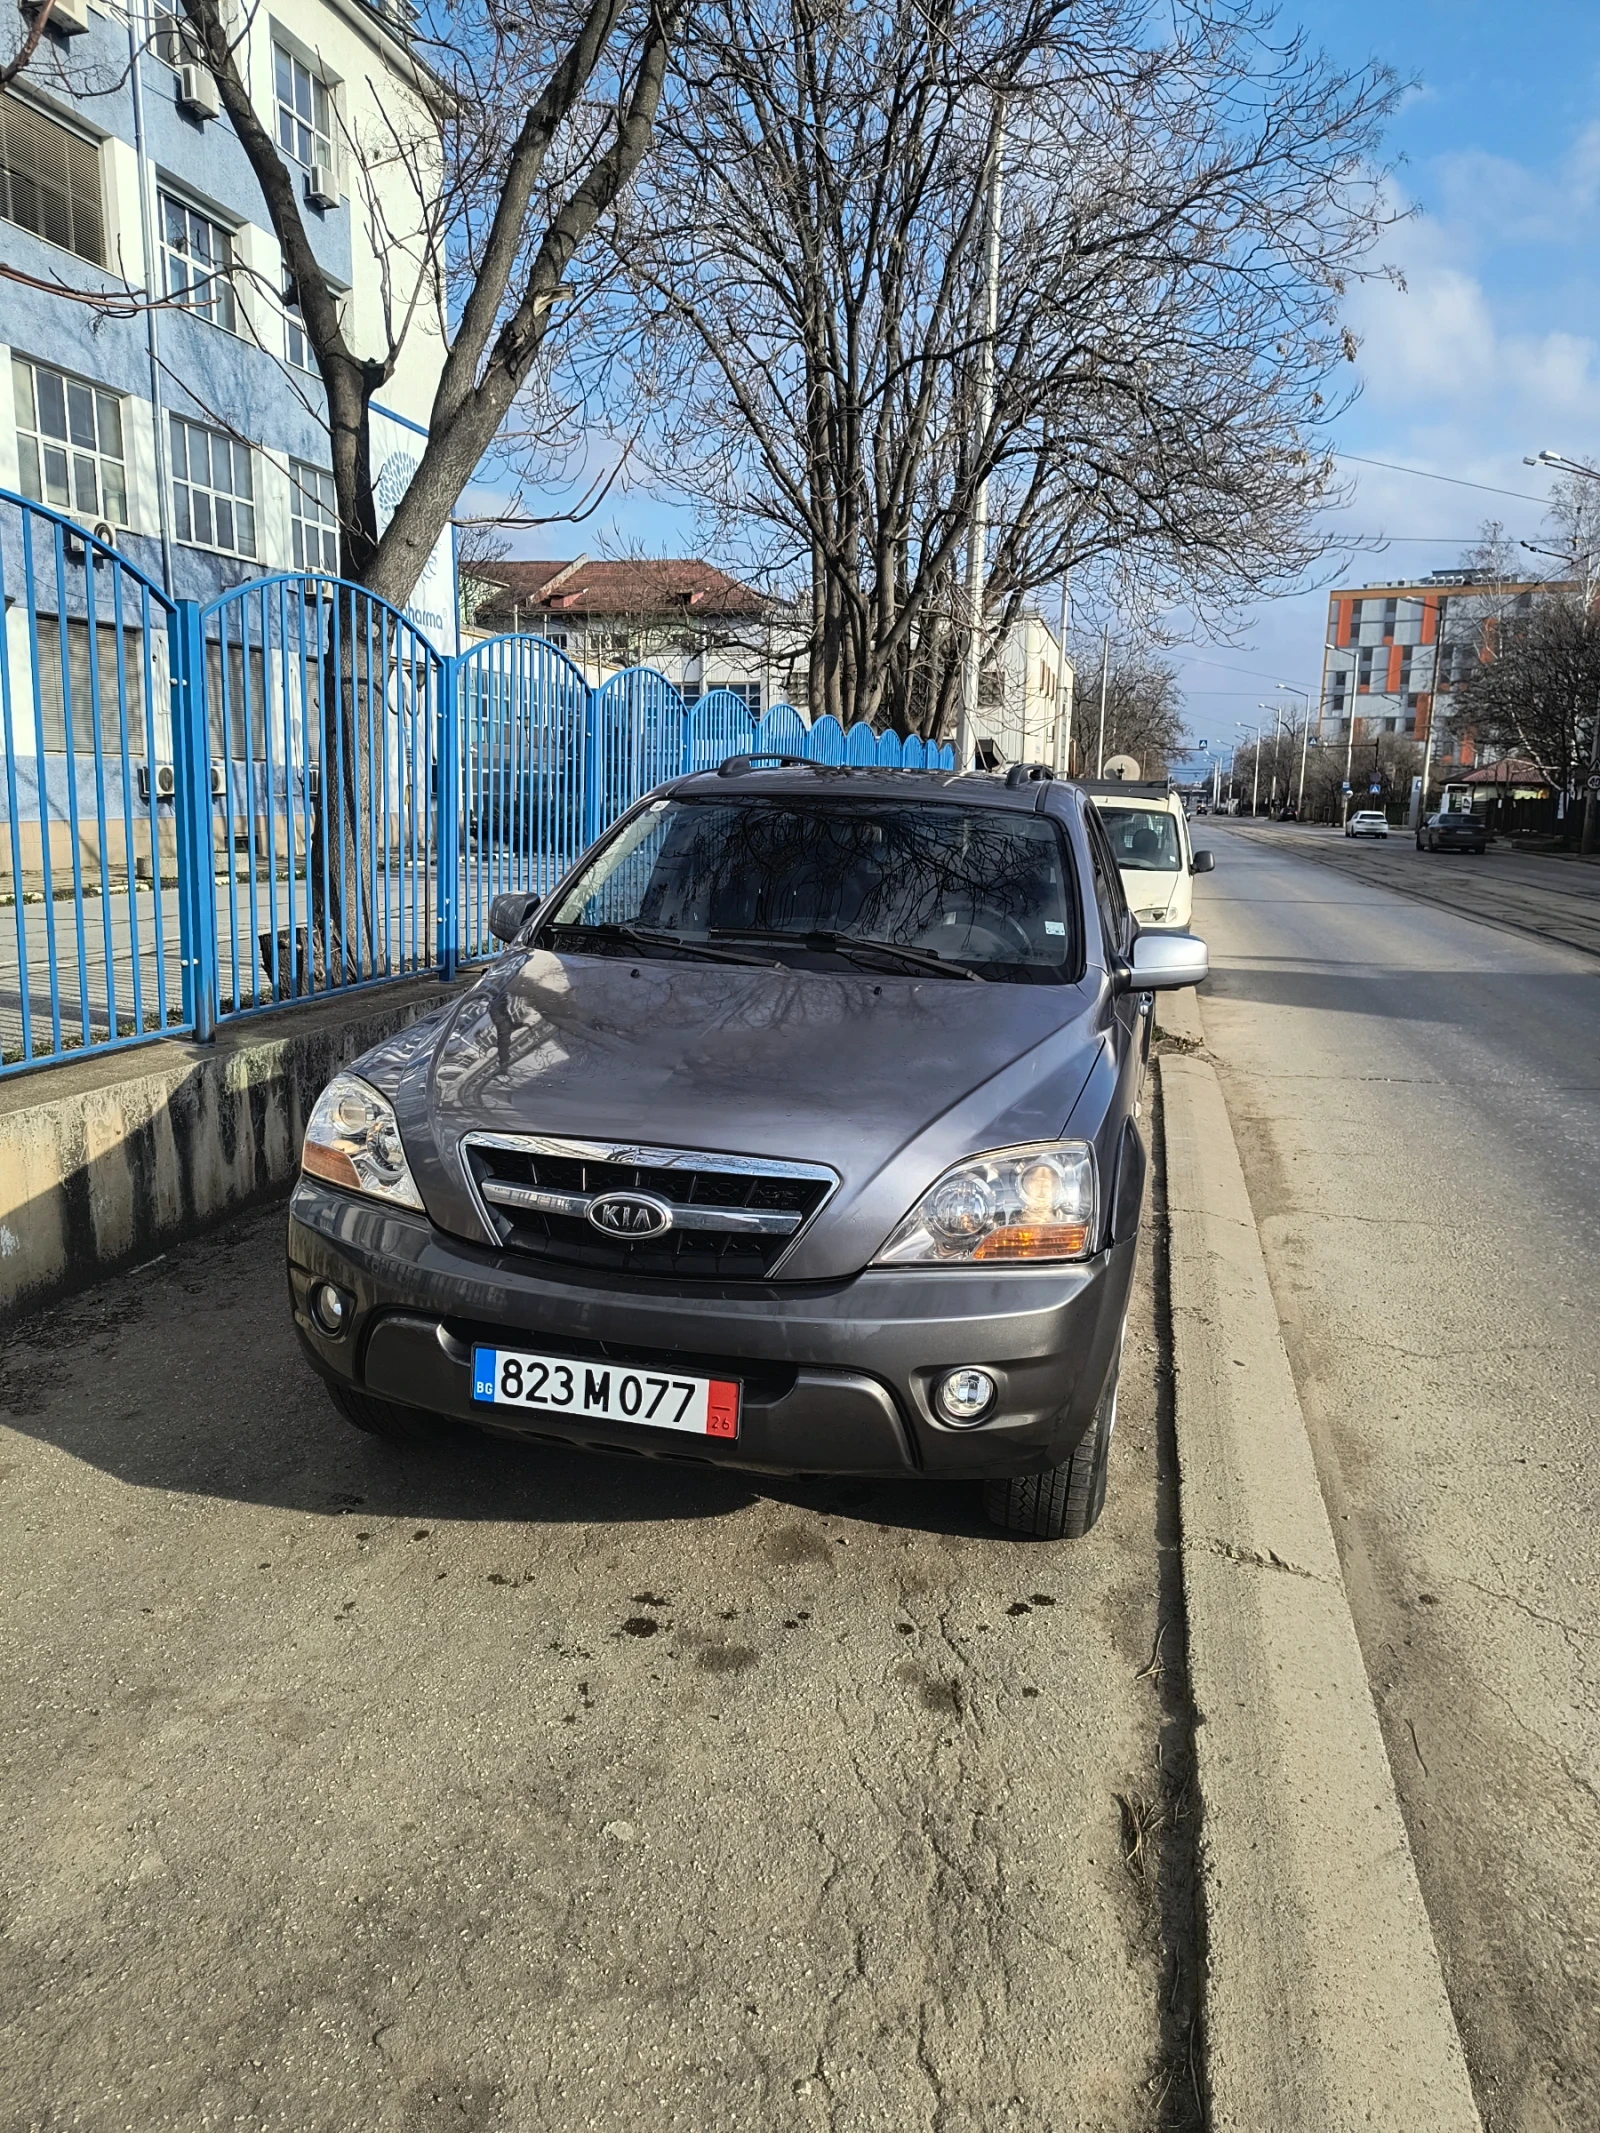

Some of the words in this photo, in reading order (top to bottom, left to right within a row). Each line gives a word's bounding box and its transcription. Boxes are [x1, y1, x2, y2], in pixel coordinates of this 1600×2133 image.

[602, 1203, 652, 1230] KIA
[476, 1381, 493, 1395] BG
[501, 1358, 574, 1406] 823
[583, 1368, 611, 1413] M
[619, 1375, 696, 1423] 077
[711, 1415, 731, 1431] 26
